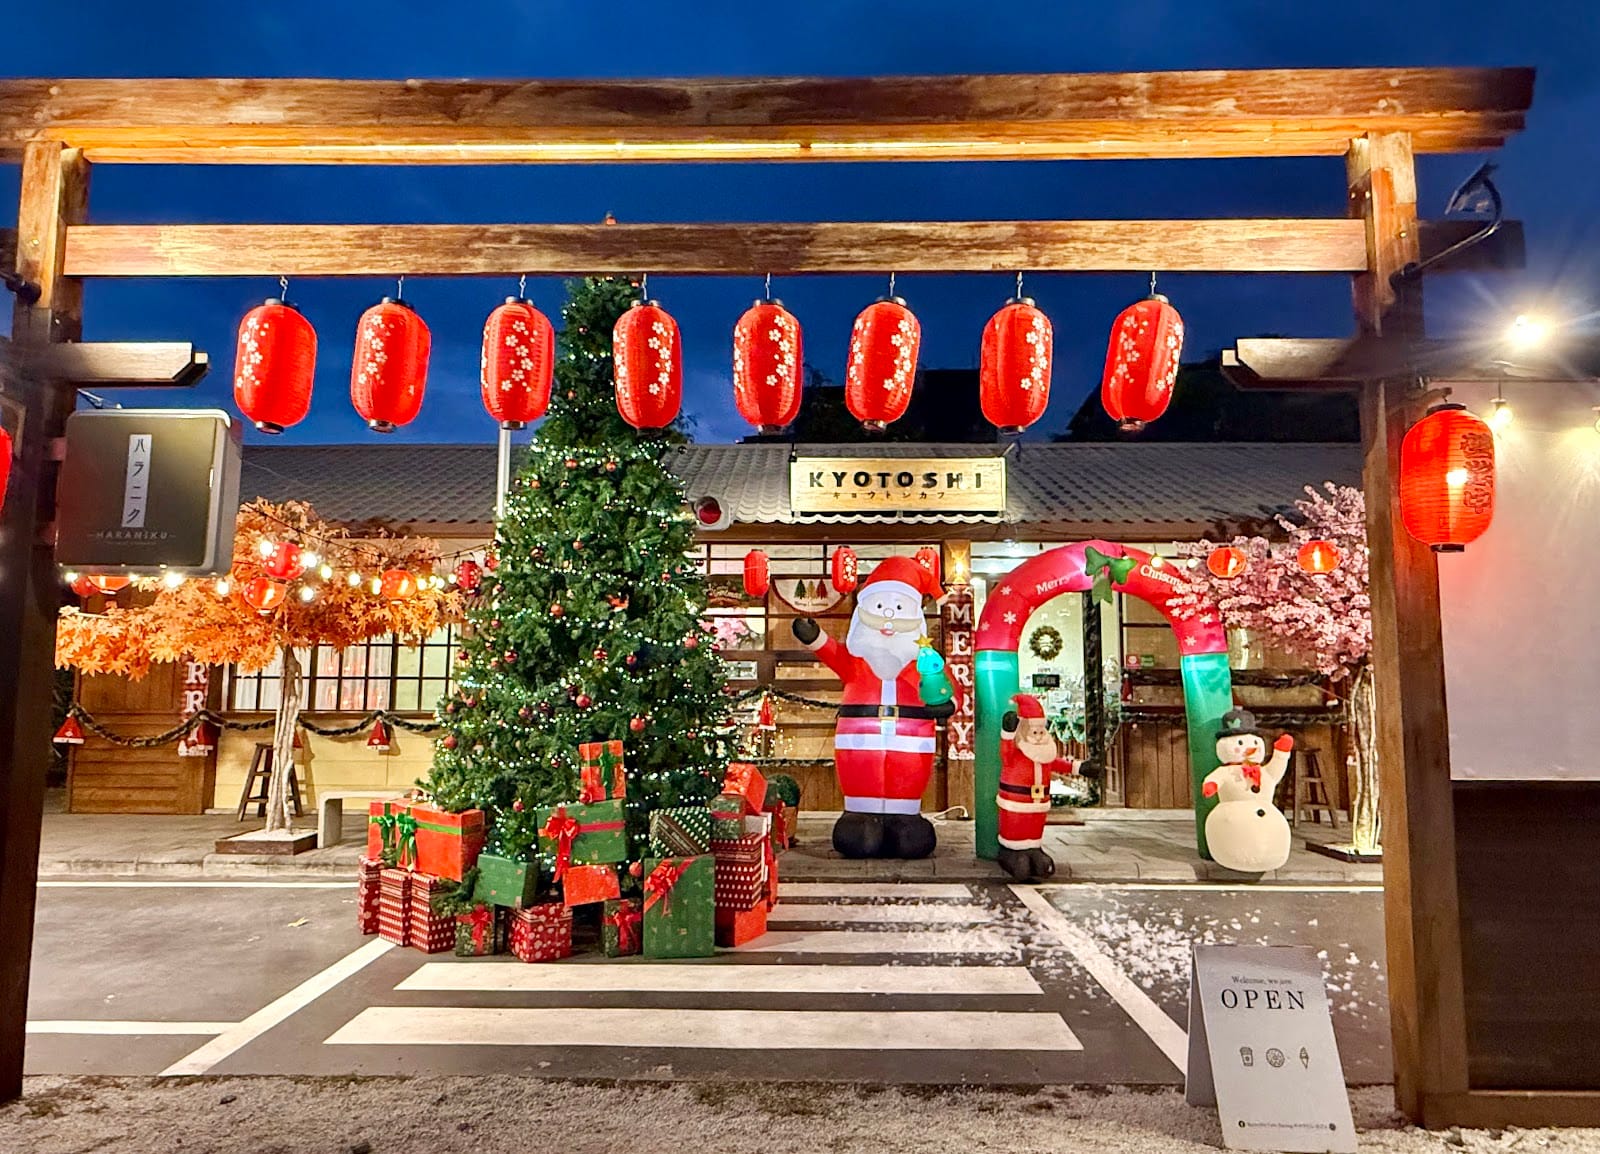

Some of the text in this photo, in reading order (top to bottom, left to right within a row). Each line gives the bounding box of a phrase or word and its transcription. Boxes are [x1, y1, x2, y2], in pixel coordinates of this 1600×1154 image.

[127, 438, 145, 524] ハラニク
[809, 471, 982, 488] KYOTOSHI
[1035, 574, 1072, 595] Merry
[1221, 988, 1305, 1010] OPEN
